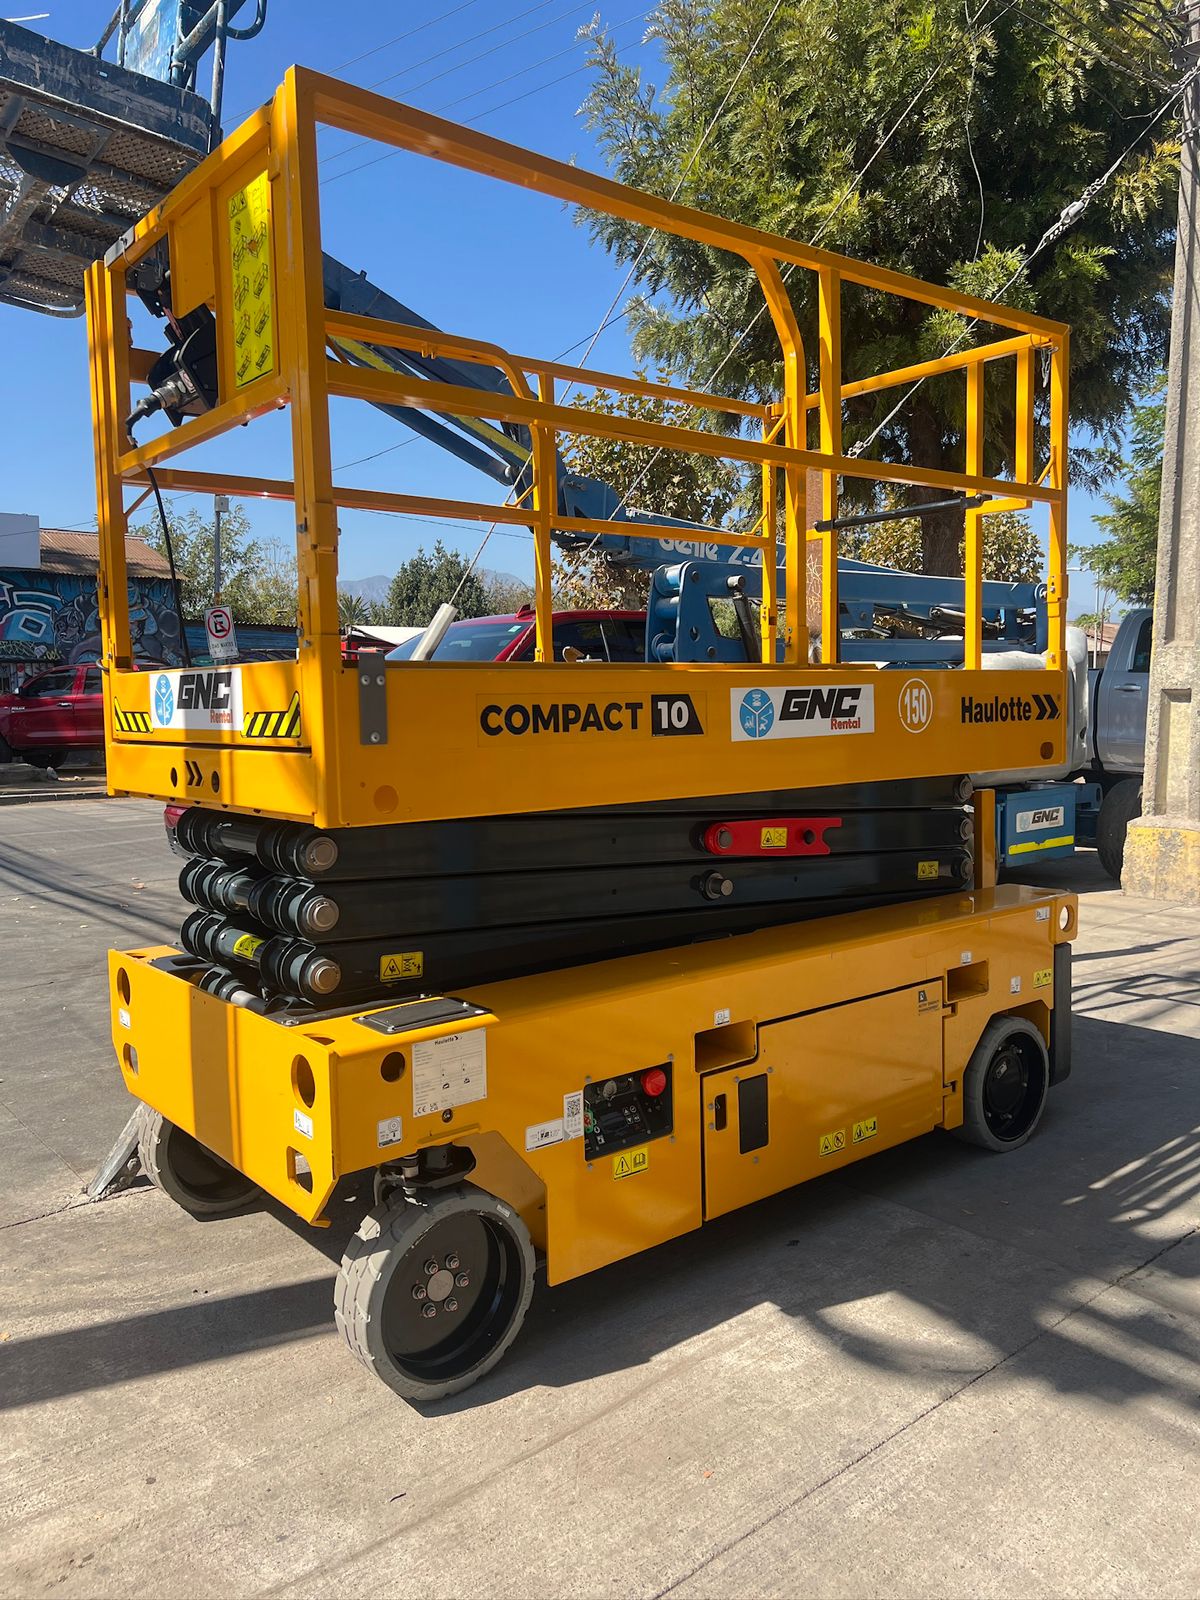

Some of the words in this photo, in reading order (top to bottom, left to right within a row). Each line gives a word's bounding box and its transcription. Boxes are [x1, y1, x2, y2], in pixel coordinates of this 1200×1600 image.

[177, 672, 232, 710] GNC
[778, 687, 862, 721] GNC
[904, 687, 927, 724] 150
[210, 709, 233, 724] Rental
[480, 702, 643, 736] COMPACT
[657, 700, 689, 729] 10
[830, 717, 861, 730] Rental
[961, 696, 1032, 724] Haulotte
[1031, 808, 1061, 824] GNC
